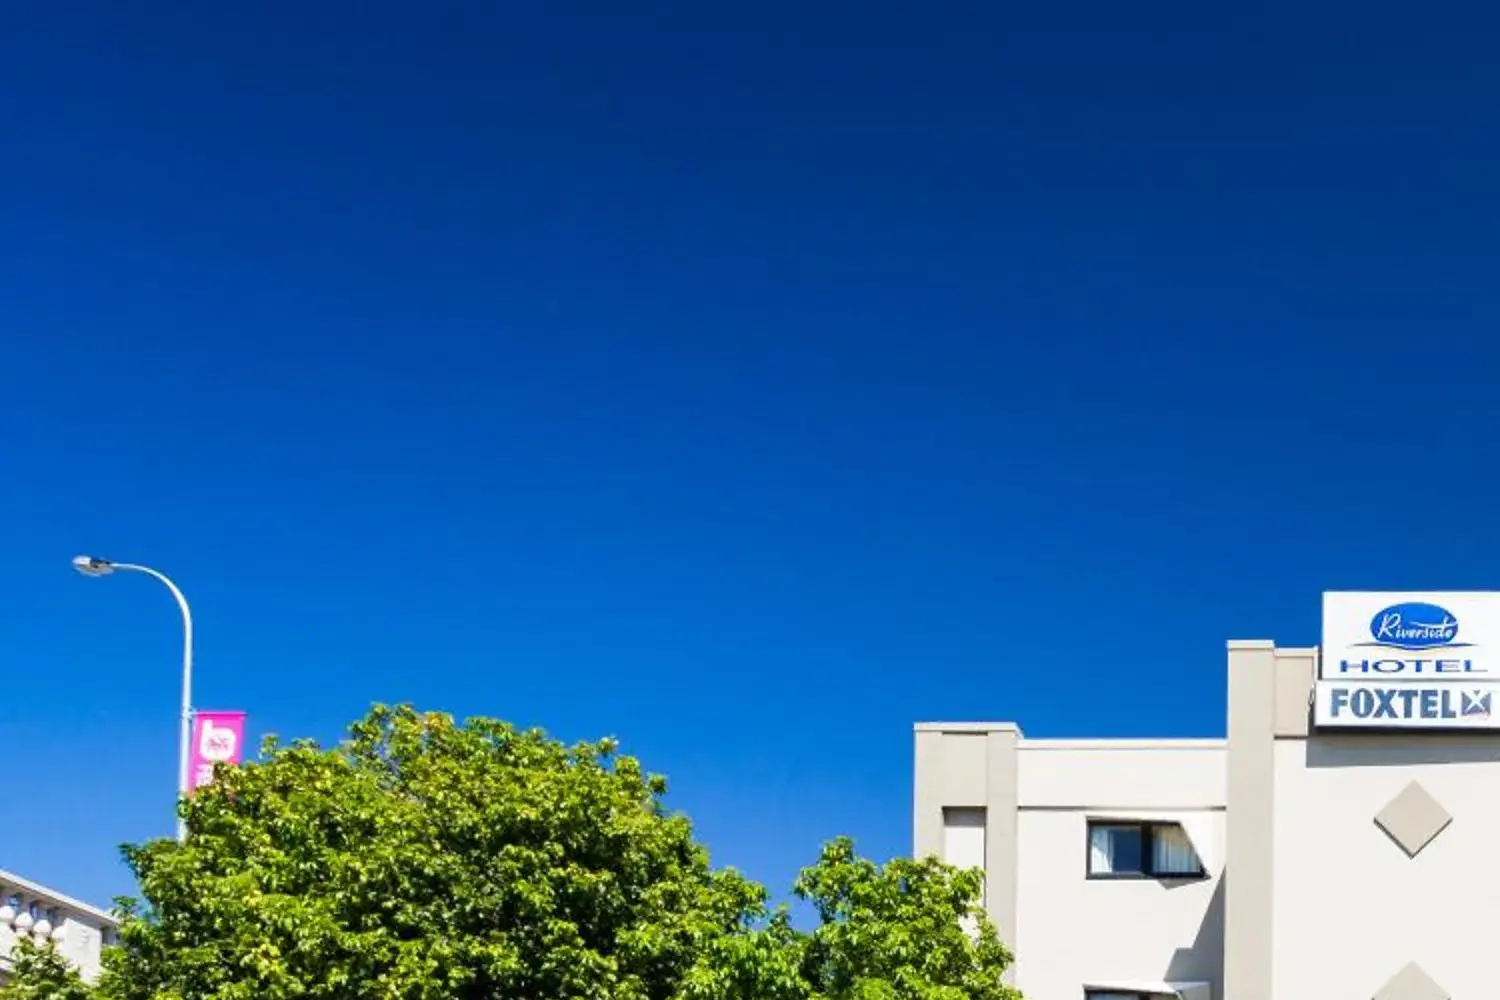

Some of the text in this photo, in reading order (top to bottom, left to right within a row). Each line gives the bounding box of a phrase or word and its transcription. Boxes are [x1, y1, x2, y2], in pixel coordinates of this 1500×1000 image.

[1378, 612, 1458, 640] Riverside
[1340, 659, 1488, 673] HOTEL
[1331, 688, 1456, 718] FOXTEL
